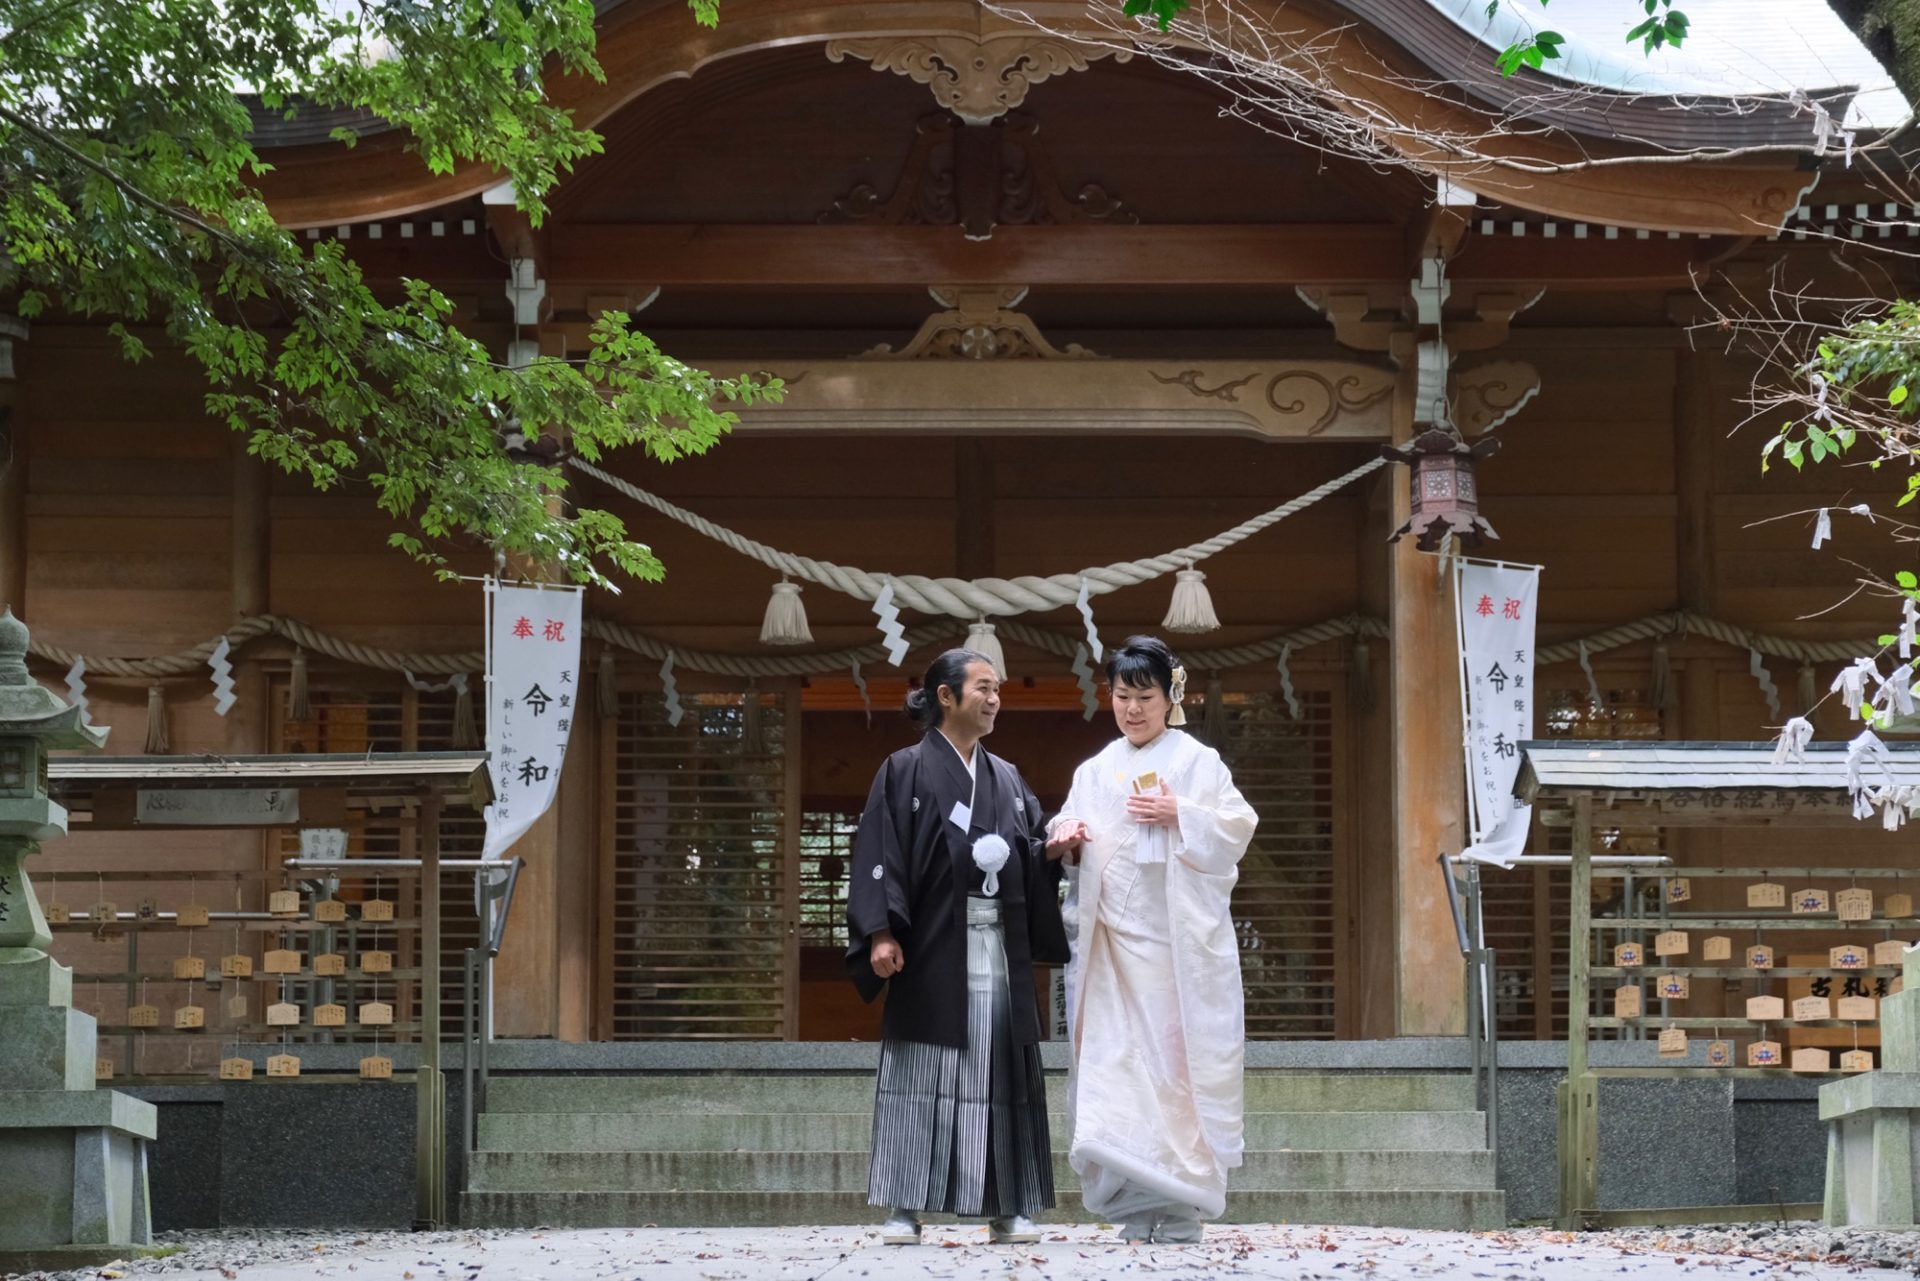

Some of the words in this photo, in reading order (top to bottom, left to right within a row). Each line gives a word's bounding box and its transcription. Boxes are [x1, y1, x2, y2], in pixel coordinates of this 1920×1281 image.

[512, 616, 565, 642] 奉祝
[1475, 594, 1521, 620] 奉祝
[516, 682, 553, 787] 令和
[553, 670, 572, 777] 天皇陛下
[1486, 661, 1516, 760] 令和
